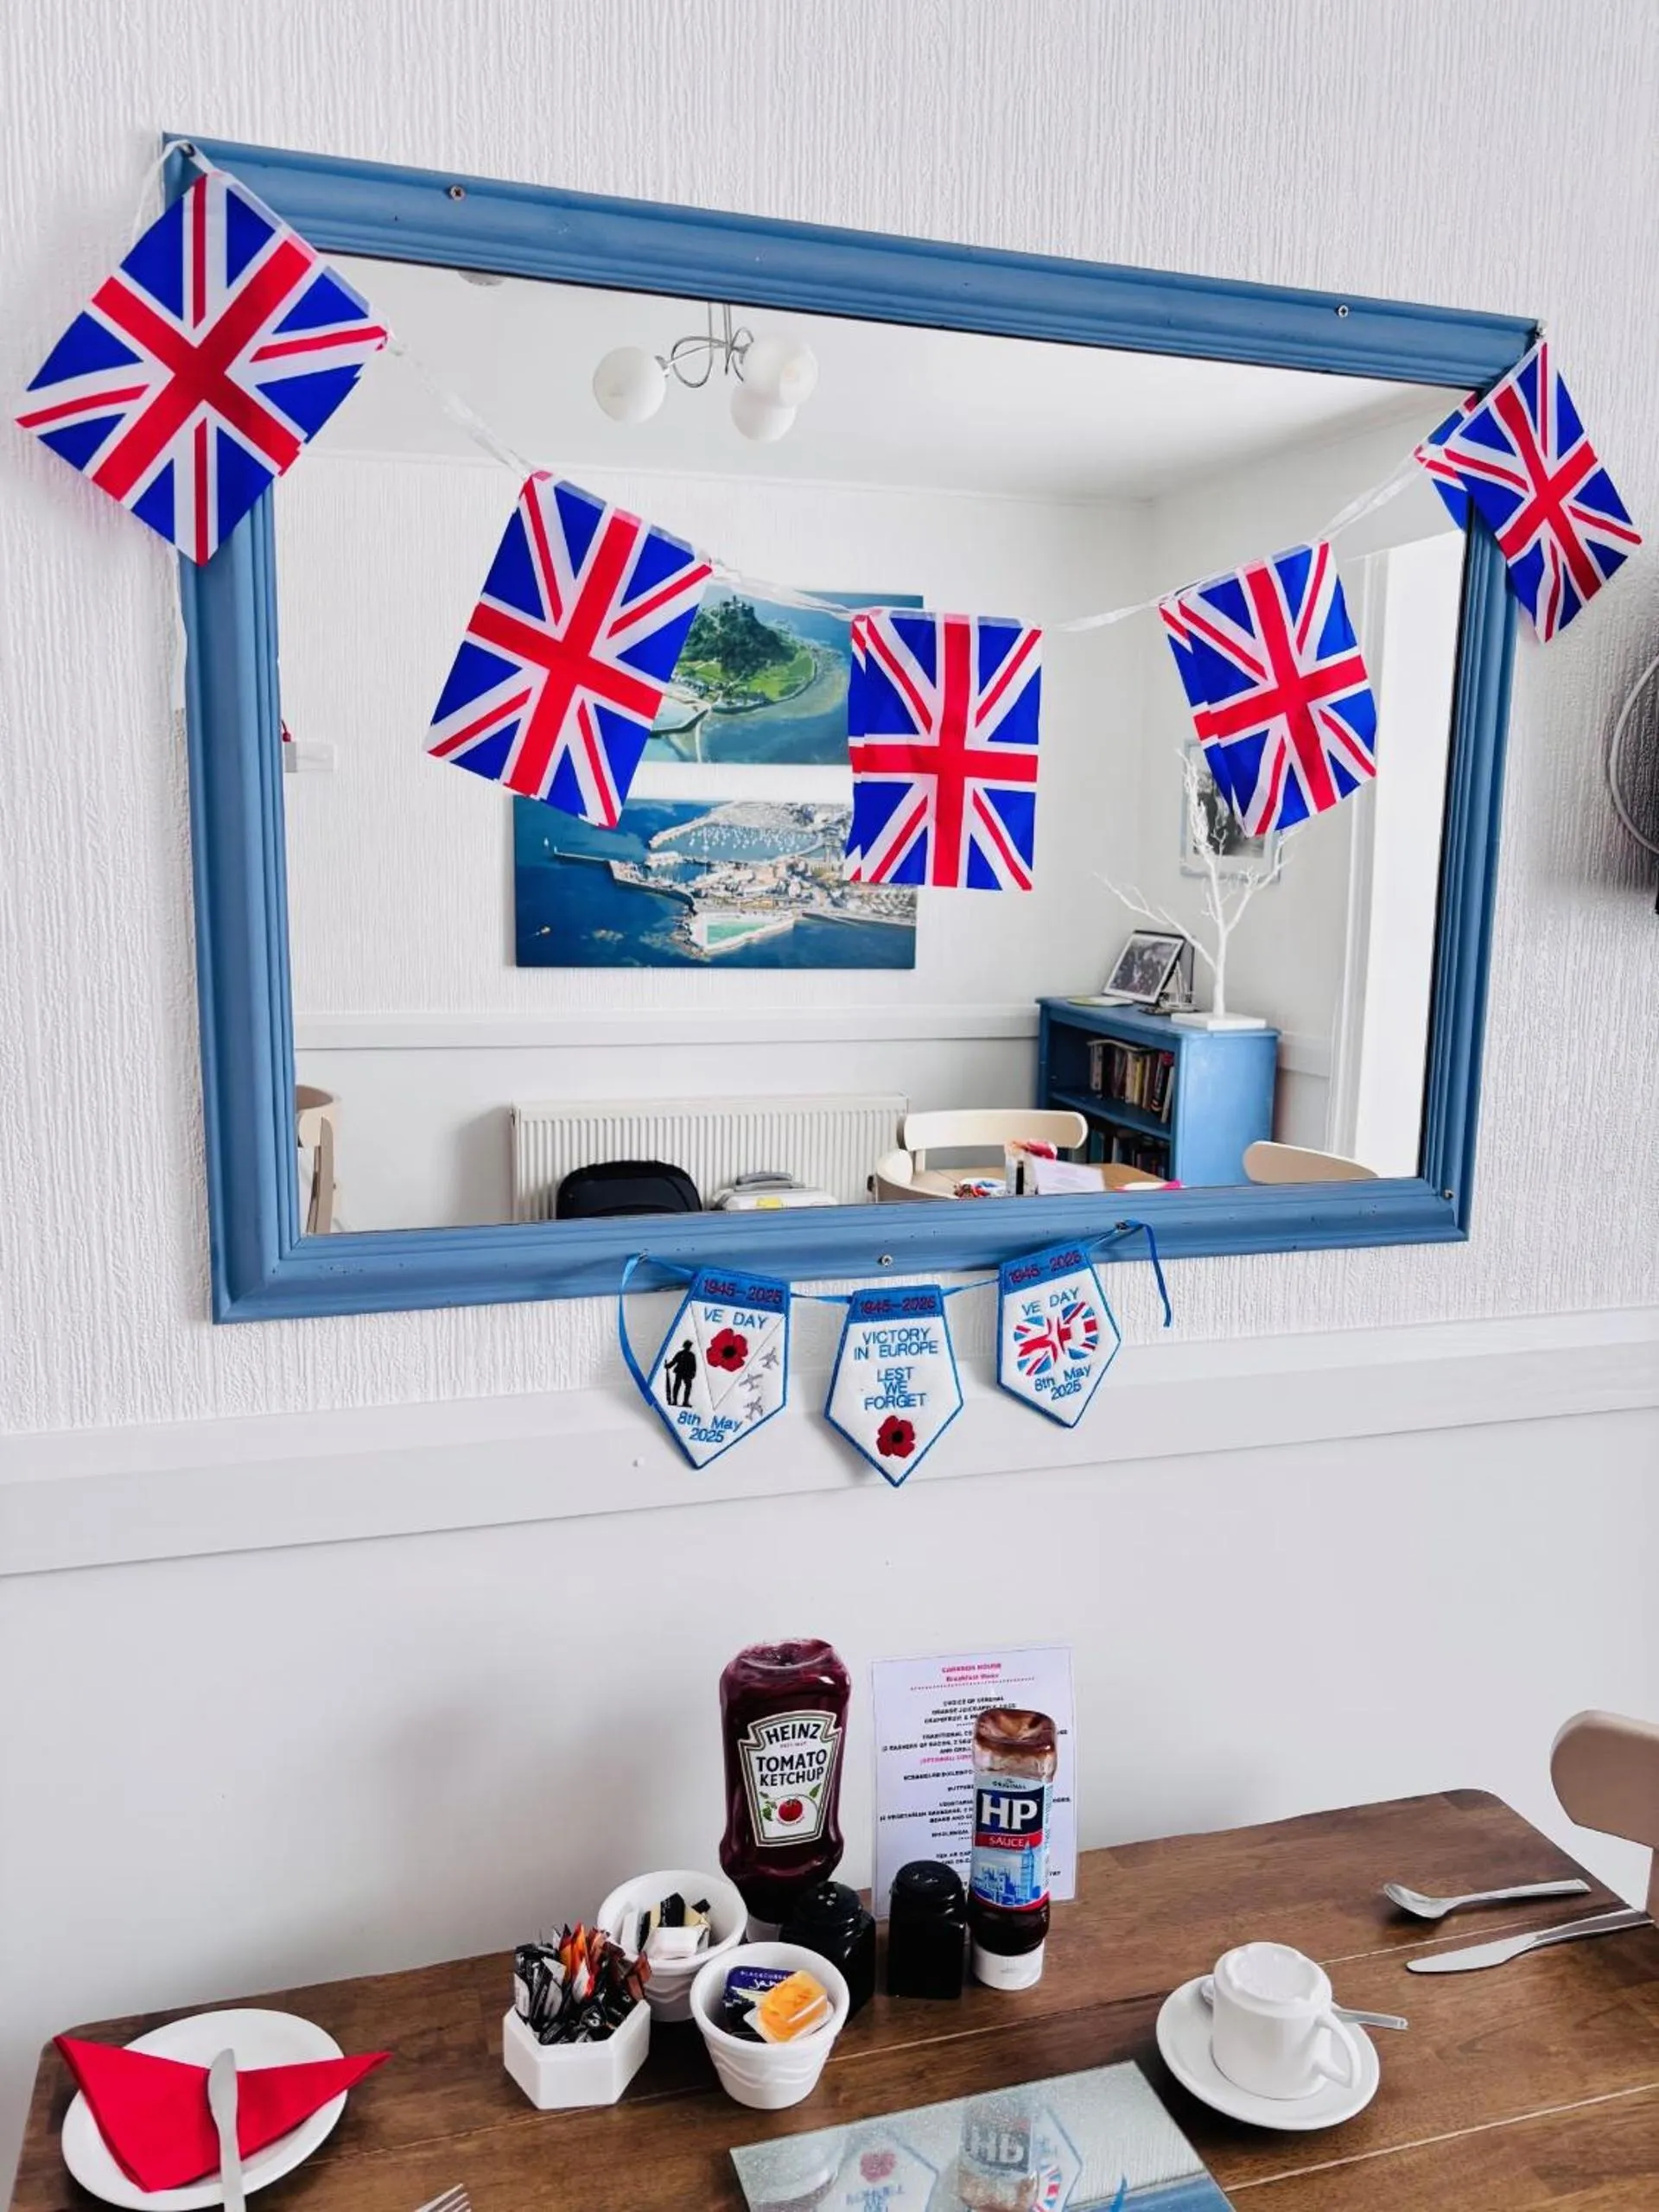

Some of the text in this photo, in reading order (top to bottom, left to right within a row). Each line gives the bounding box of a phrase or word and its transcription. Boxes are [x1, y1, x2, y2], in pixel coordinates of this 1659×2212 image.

[1021, 1287, 1079, 1316] VE DAY
[704, 1306, 767, 1330] VE DAY
[861, 1327, 931, 1345] VICTORY
[854, 1340, 938, 1361] IN EUROPE
[876, 1366, 915, 1382] LEST
[1034, 1364, 1091, 1392] 8th May
[883, 1381, 908, 1395] WE
[1051, 1380, 1083, 1401] 2025
[864, 1393, 927, 1411] FORGET
[677, 1410, 743, 1433] 8th May
[689, 1427, 725, 1443] 2025
[765, 1723, 822, 1745] HEINZ
[756, 1749, 828, 1772] TOMATO
[760, 1766, 824, 1787] KETCHUP
[981, 1792, 1038, 1830] HP
[988, 1837, 1025, 1847] SAUCE
